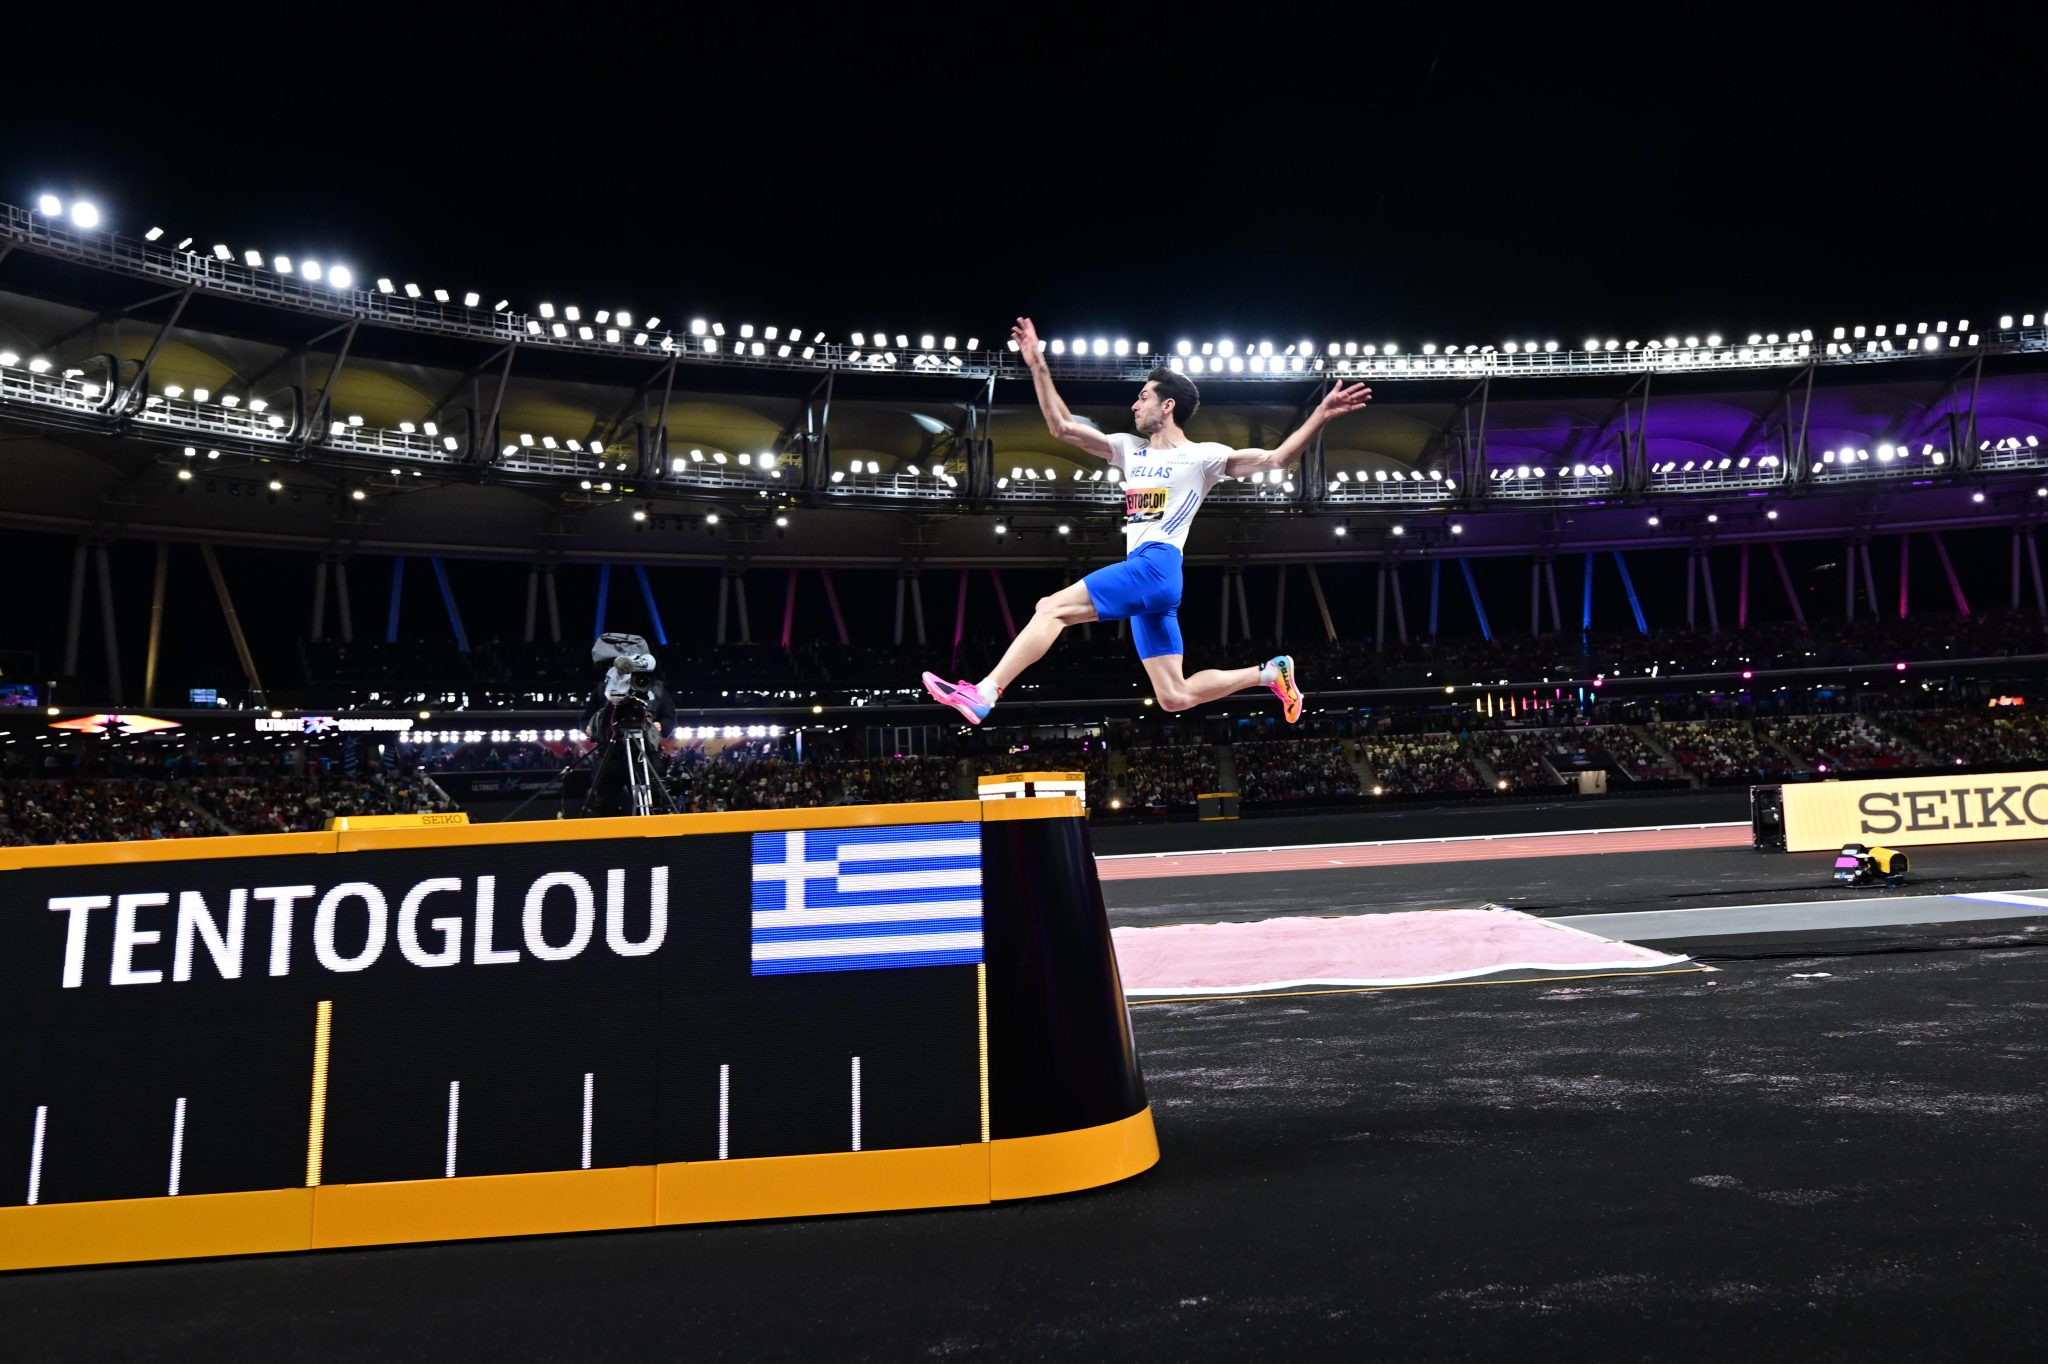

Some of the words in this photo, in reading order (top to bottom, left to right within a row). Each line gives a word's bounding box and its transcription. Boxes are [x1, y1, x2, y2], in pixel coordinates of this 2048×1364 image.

[1130, 466, 1172, 478] HELLAS
[421, 814, 463, 825] SEIKO
[48, 866, 669, 989] TENTOGLOU
